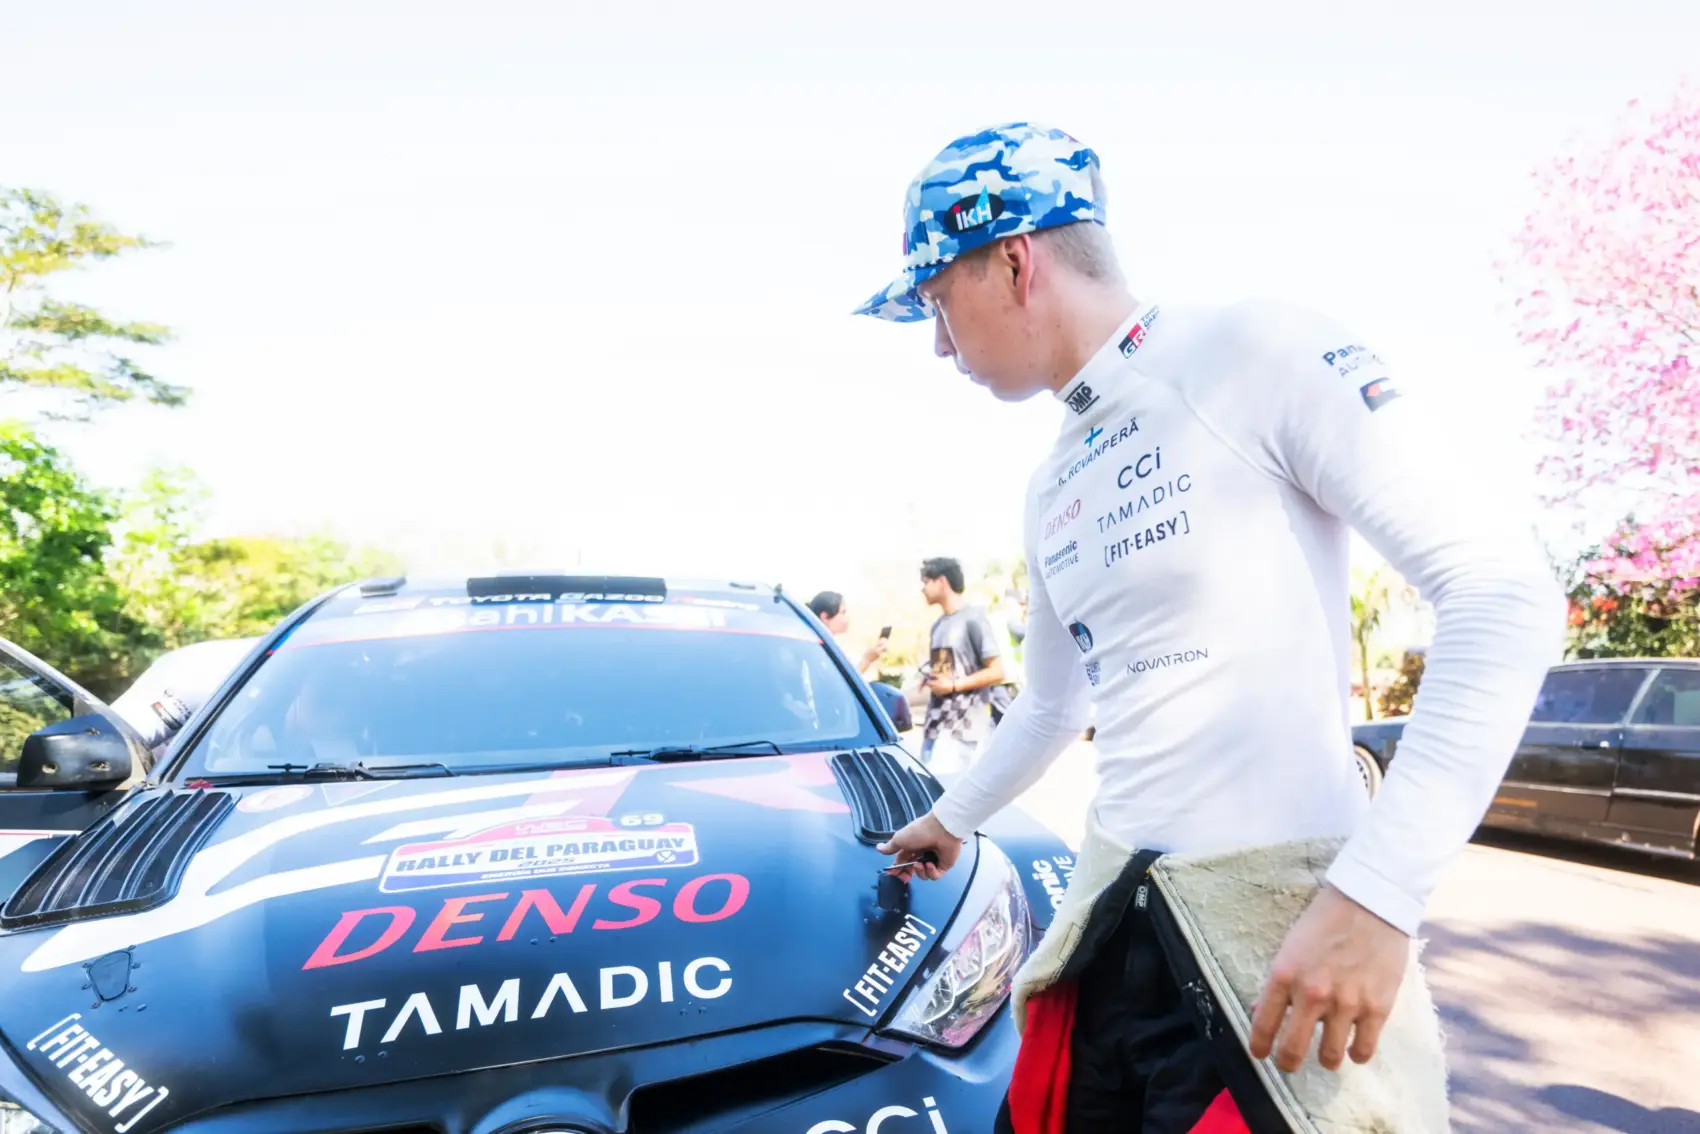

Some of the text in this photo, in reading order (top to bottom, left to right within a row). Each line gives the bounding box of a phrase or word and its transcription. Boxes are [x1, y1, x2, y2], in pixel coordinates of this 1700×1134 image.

[1120, 325, 1146, 359] GR
[1066, 385, 1093, 413] OMP
[1067, 417, 1139, 480] ROVANPERÄ
[1044, 498, 1081, 540] DENSO
[1097, 474, 1192, 533] TAMADIC
[1044, 539, 1078, 568] Panasonic
[1126, 647, 1209, 675] NOVATRON
[620, 813, 665, 827] 69
[395, 837, 686, 873] RALLY DEL PARAGUAY
[301, 872, 750, 970] DENSO
[330, 956, 733, 1051] TAMADIC
